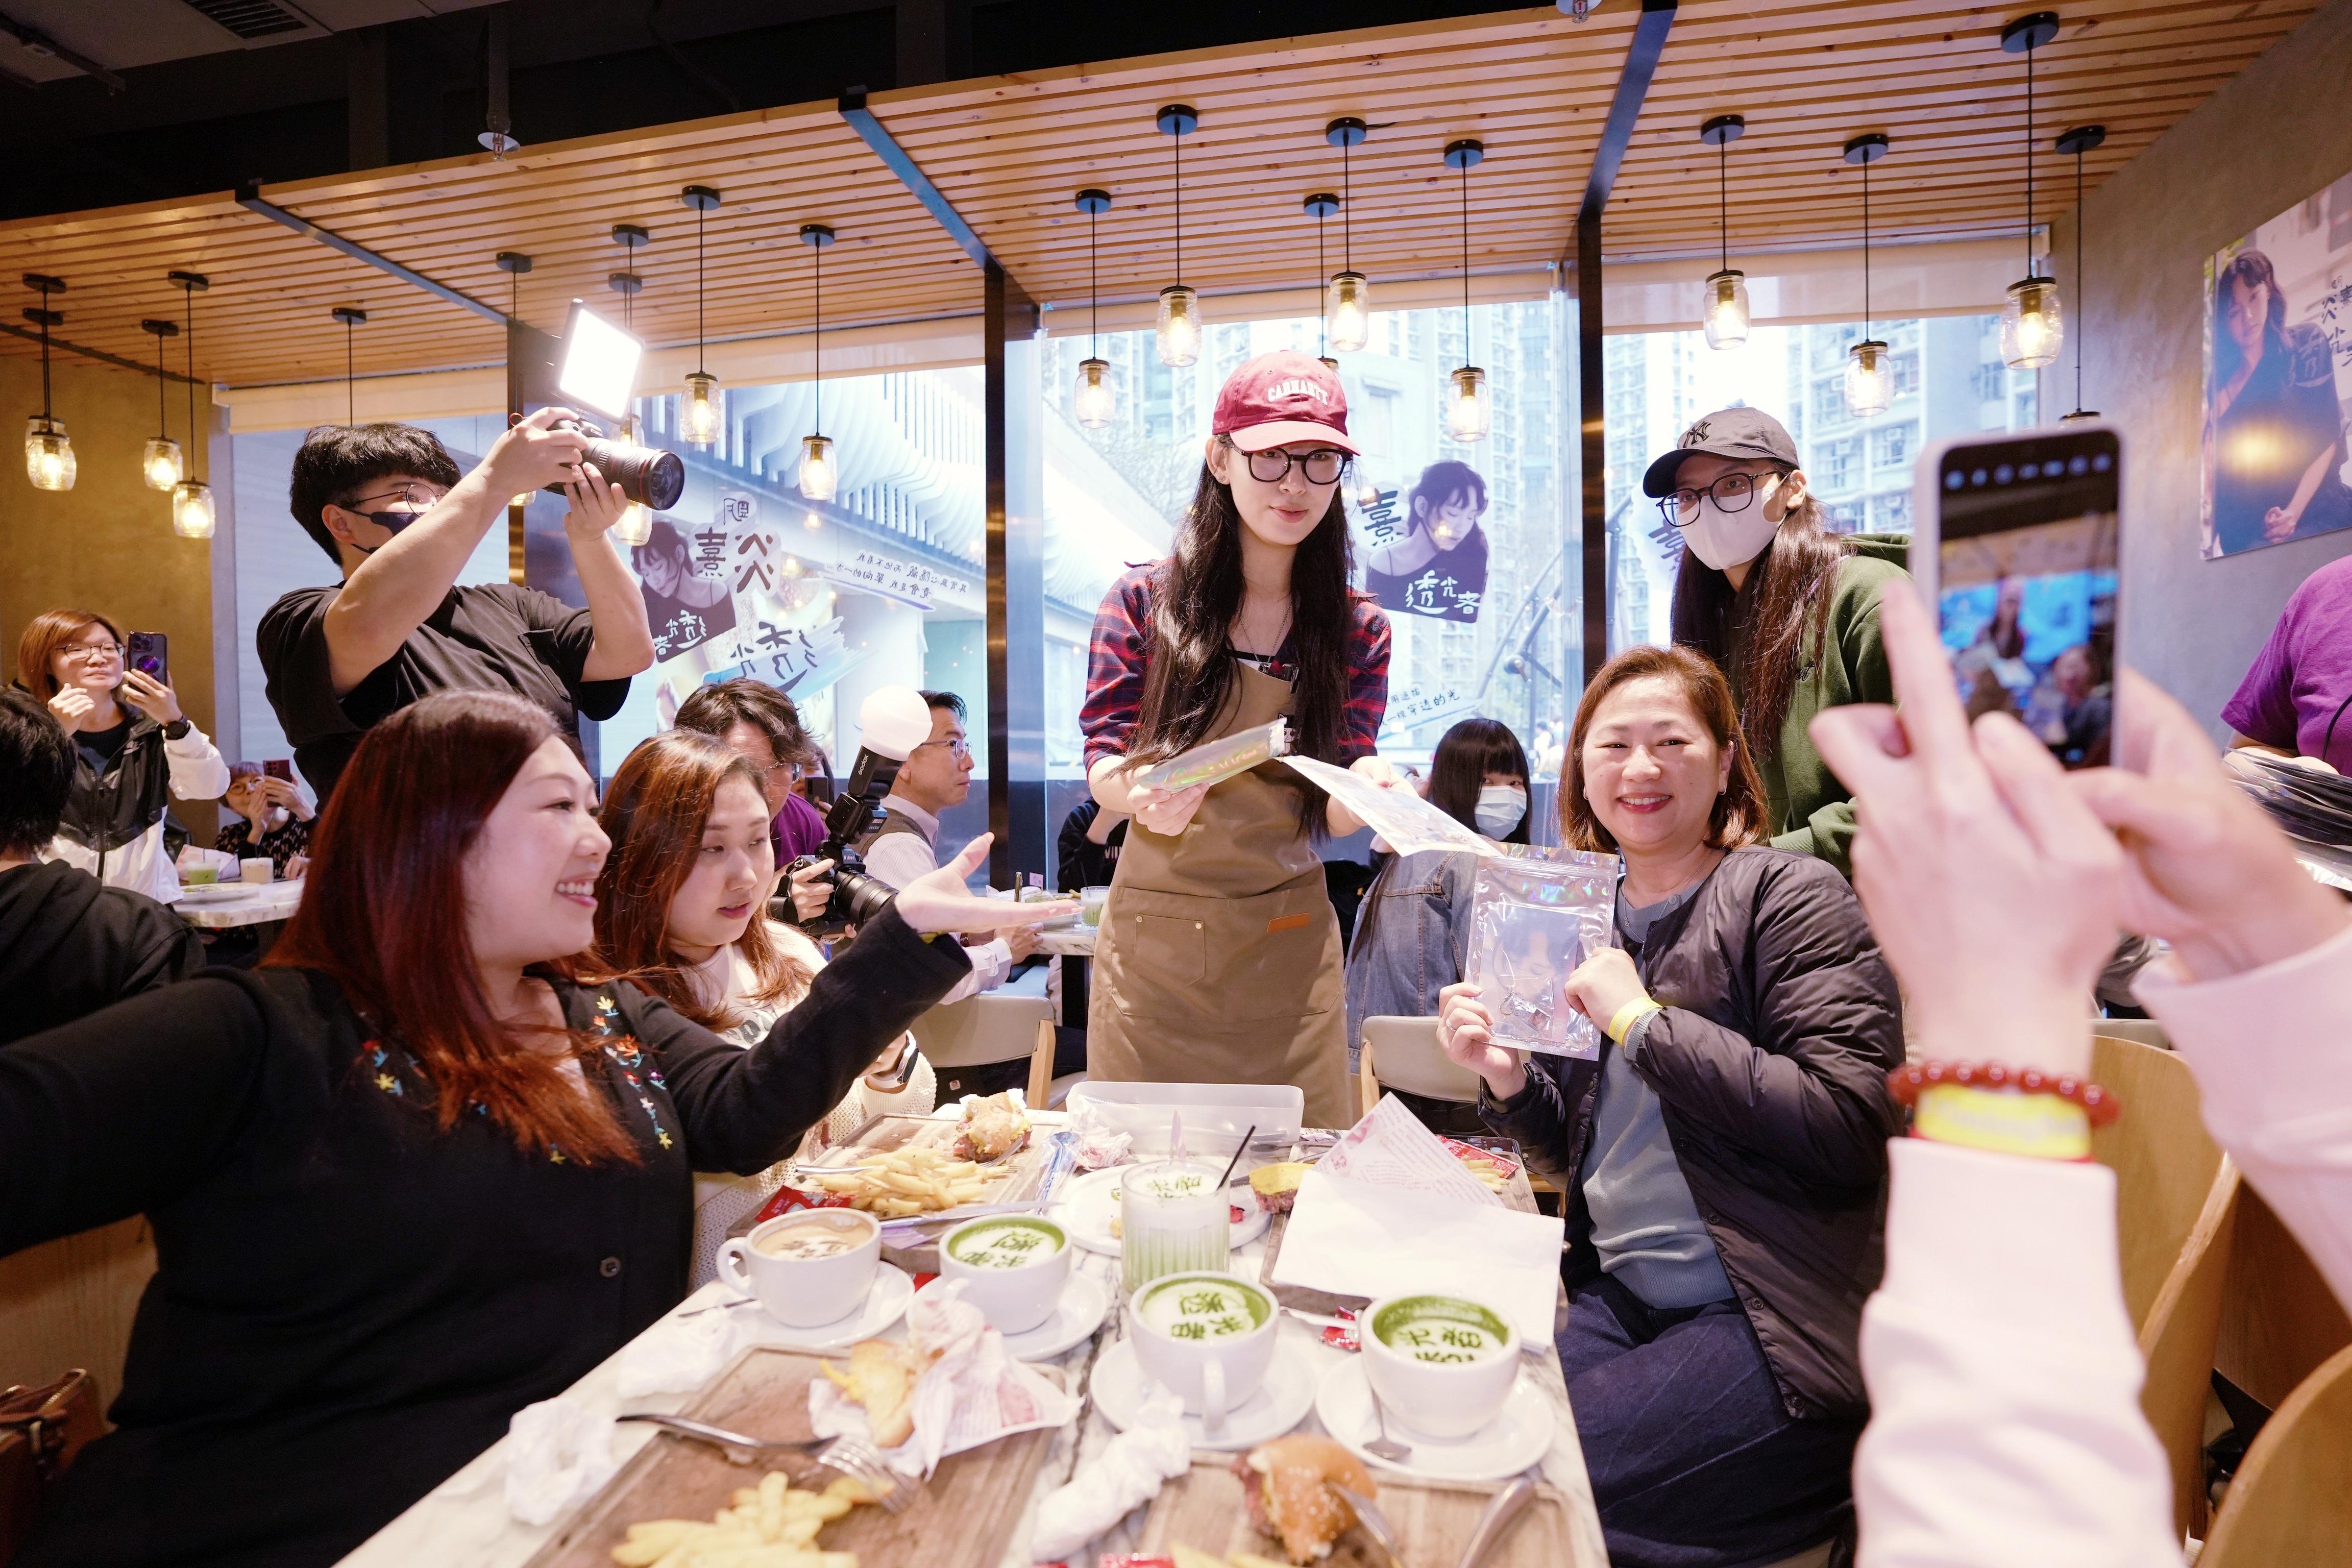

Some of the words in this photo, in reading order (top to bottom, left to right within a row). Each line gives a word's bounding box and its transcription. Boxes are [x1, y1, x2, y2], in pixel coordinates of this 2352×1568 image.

[1267, 379, 1328, 406] CARHARTT
[1405, 570, 1482, 615] 透光者
[858, 754, 869, 775] Godox
